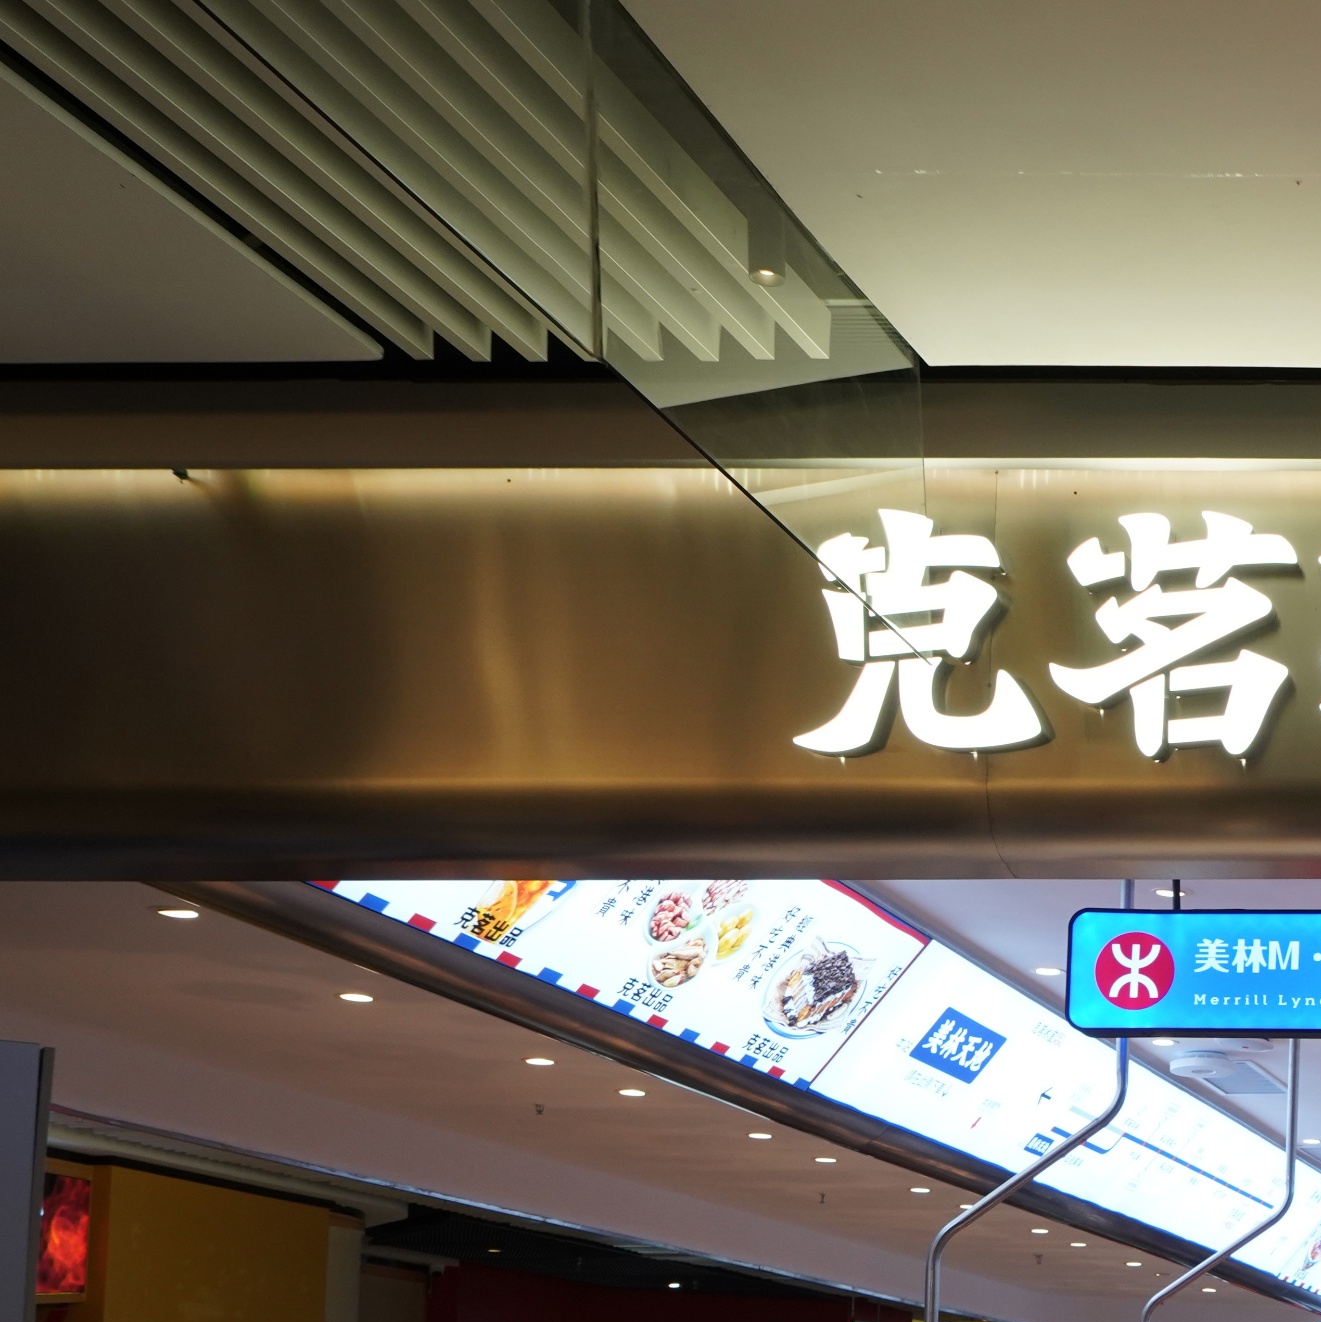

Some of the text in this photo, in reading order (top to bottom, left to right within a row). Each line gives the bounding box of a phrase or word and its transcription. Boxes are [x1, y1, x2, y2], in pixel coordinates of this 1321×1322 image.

[453, 907, 525, 948] 克茗出品
[616, 976, 675, 1013] 克茗出品
[1193, 993, 1268, 1007] Merrill
[741, 1032, 790, 1064] 克茗出品
[921, 1018, 994, 1073] 美林天地
